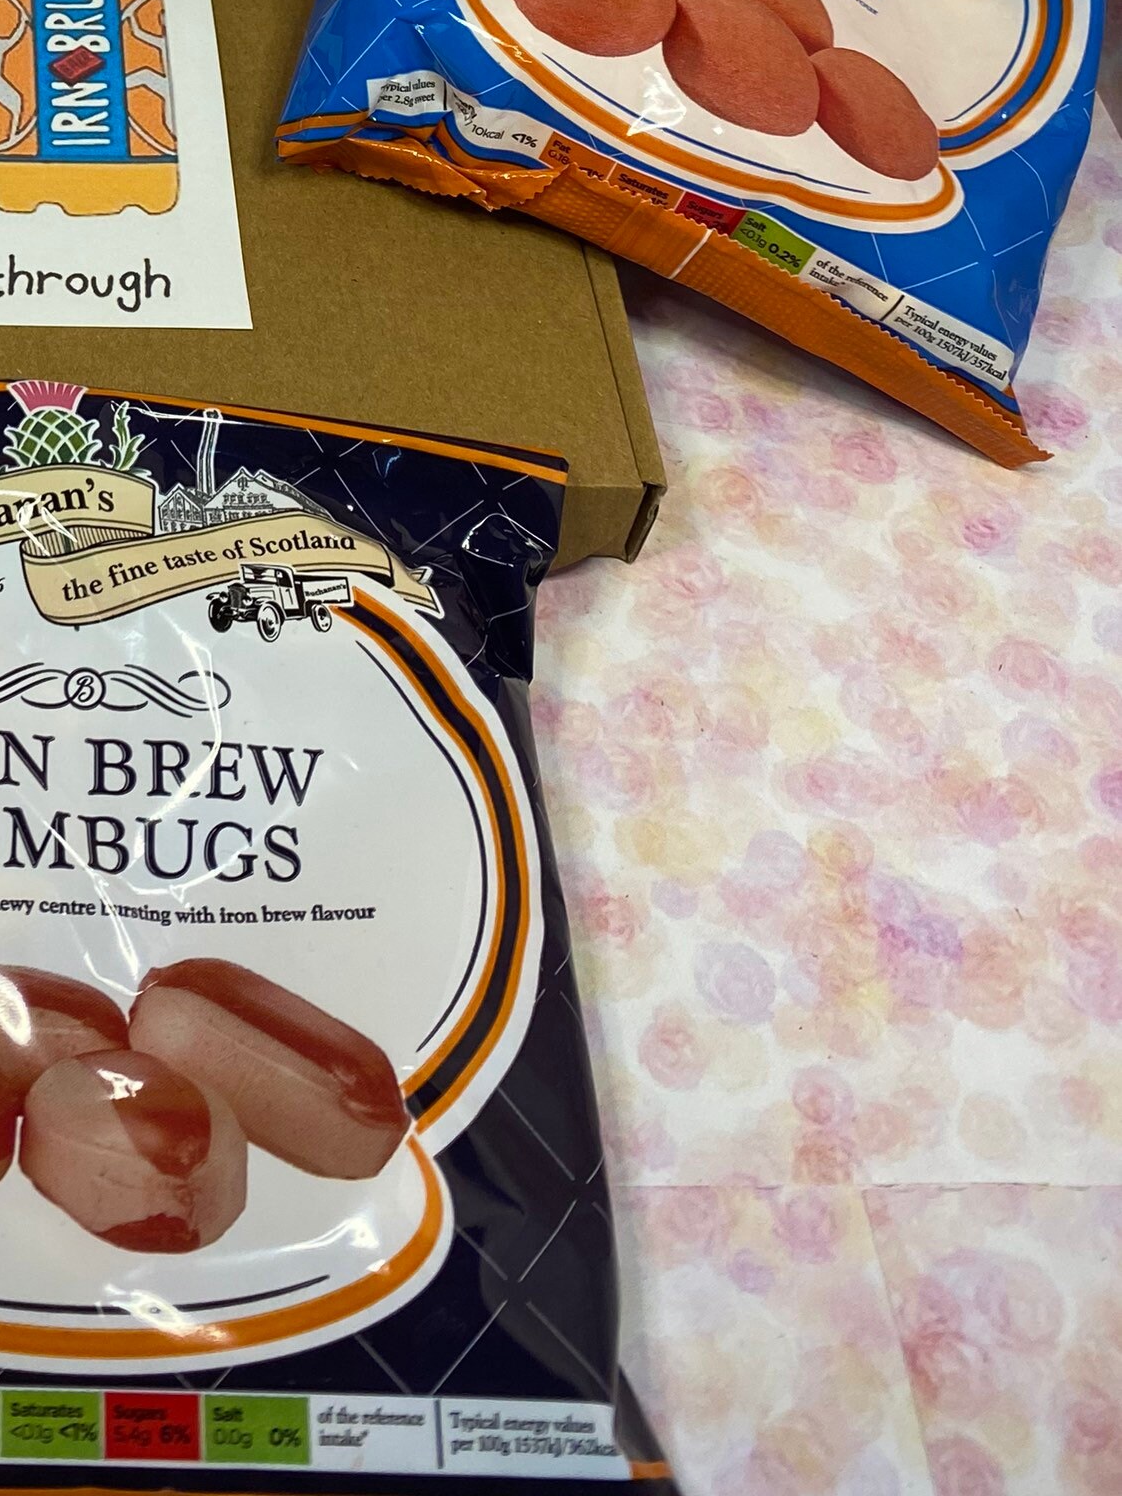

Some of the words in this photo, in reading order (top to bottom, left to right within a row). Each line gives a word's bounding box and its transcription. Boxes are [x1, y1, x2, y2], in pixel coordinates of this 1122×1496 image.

[51, 81, 111, 147] IRN
[471, 123, 505, 140] 10kcal
[512, 133, 538, 148] <1%
[553, 140, 572, 154] Fat
[618, 173, 669, 200] Saturates
[745, 217, 766, 233] Salt
[768, 243, 802, 268] 0.2%
[816, 259, 830, 270] of
[828, 265, 845, 280] the
[845, 275, 889, 302] reference
[894, 316, 913, 328] per
[913, 326, 936, 343] 100g
[904, 305, 940, 331] Typical
[938, 326, 969, 349] energy
[970, 343, 998, 362] values
[61, 579, 105, 603] the
[107, 564, 160, 589] fine
[162, 547, 218, 571] taste
[223, 538, 246, 560] of
[249, 529, 357, 556] Scotland
[84, 737, 325, 807] BREW
[38, 896, 96, 915] centre
[175, 905, 216, 924] with
[220, 906, 258, 924] iron
[262, 905, 306, 923] brew
[311, 904, 376, 921] flavour
[10, 1402, 85, 1419] Saturates
[212, 1406, 244, 1422] Salt
[269, 1427, 302, 1447] 0%
